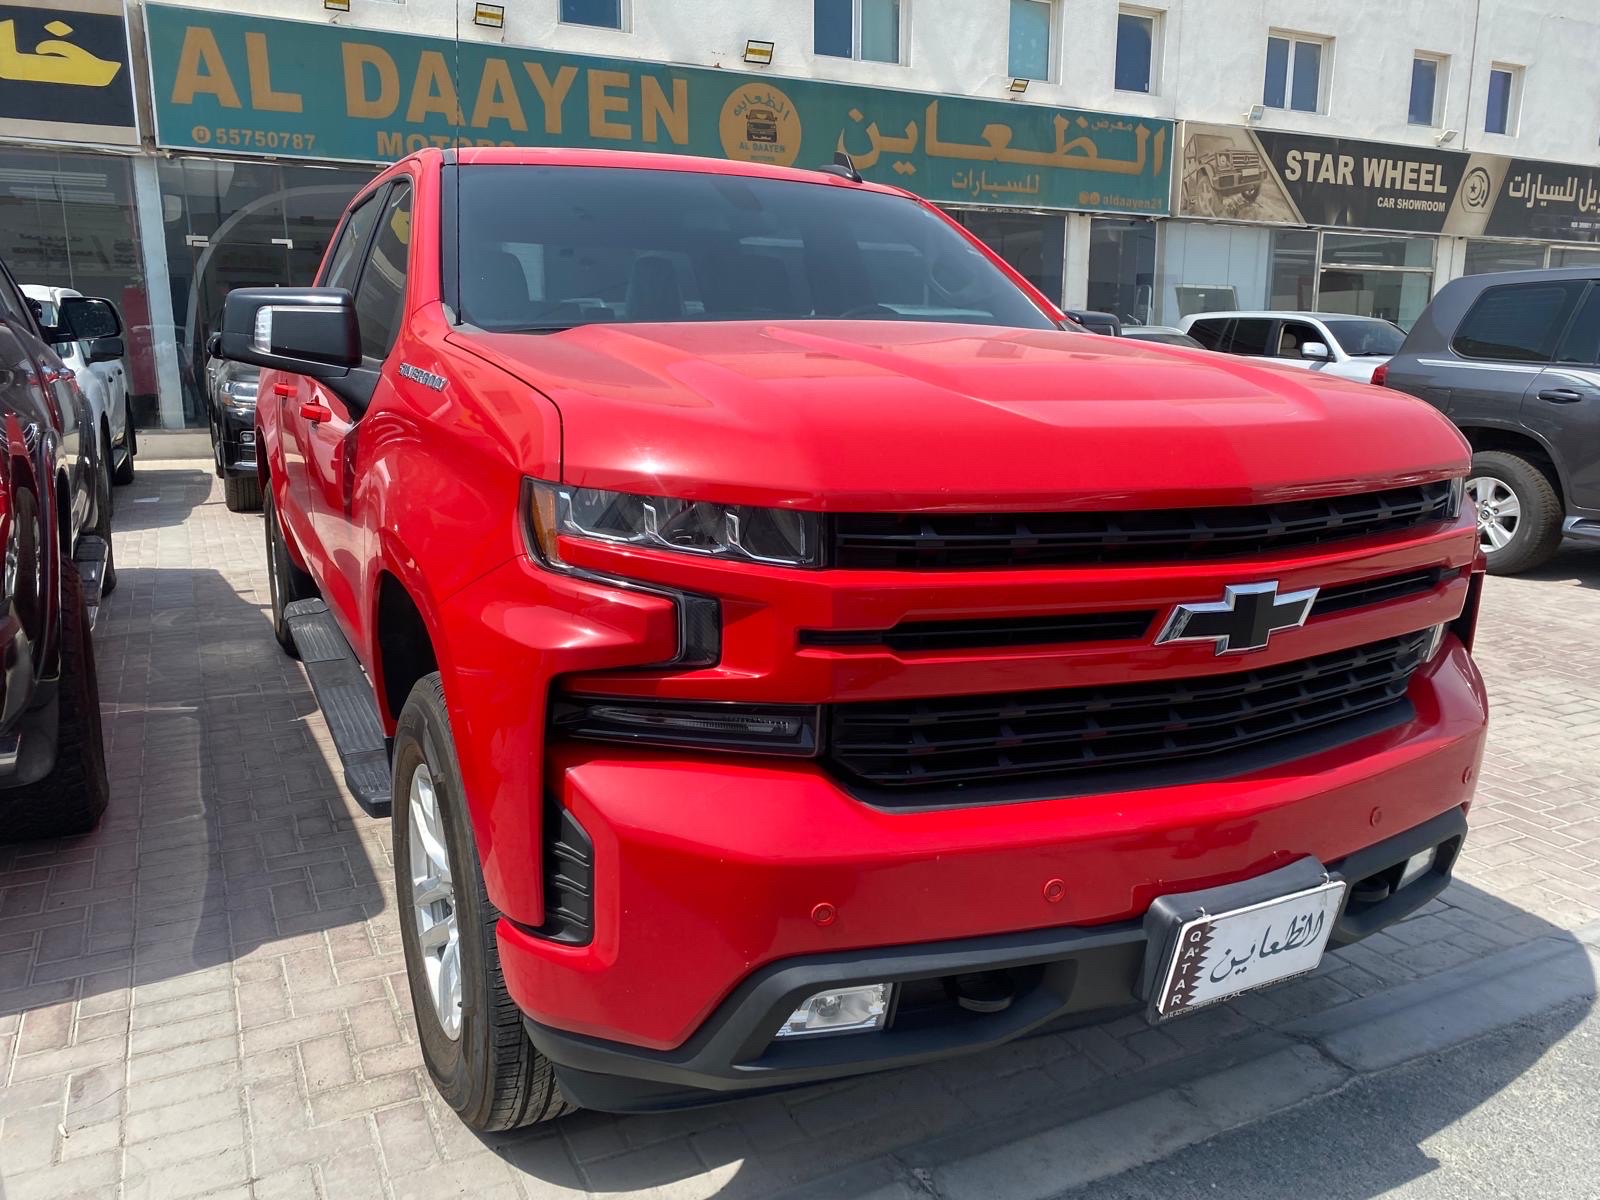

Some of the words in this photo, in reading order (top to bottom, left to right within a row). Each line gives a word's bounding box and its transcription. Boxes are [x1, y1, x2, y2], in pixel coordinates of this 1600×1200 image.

[171, 26, 303, 113] AL
[341, 42, 689, 146] DAAYEN
[215, 127, 316, 150] 55750787
[837, 100, 1166, 176] الظعاين
[952, 168, 1040, 198] للسيارات
[1285, 149, 1355, 187] STAR
[1362, 157, 1448, 194] WHEEL
[1508, 172, 1578, 209] للسيارات
[1377, 196, 1394, 209] CAR
[1397, 198, 1446, 213] SHOWROOM
[1170, 930, 1202, 1007] QATAR
